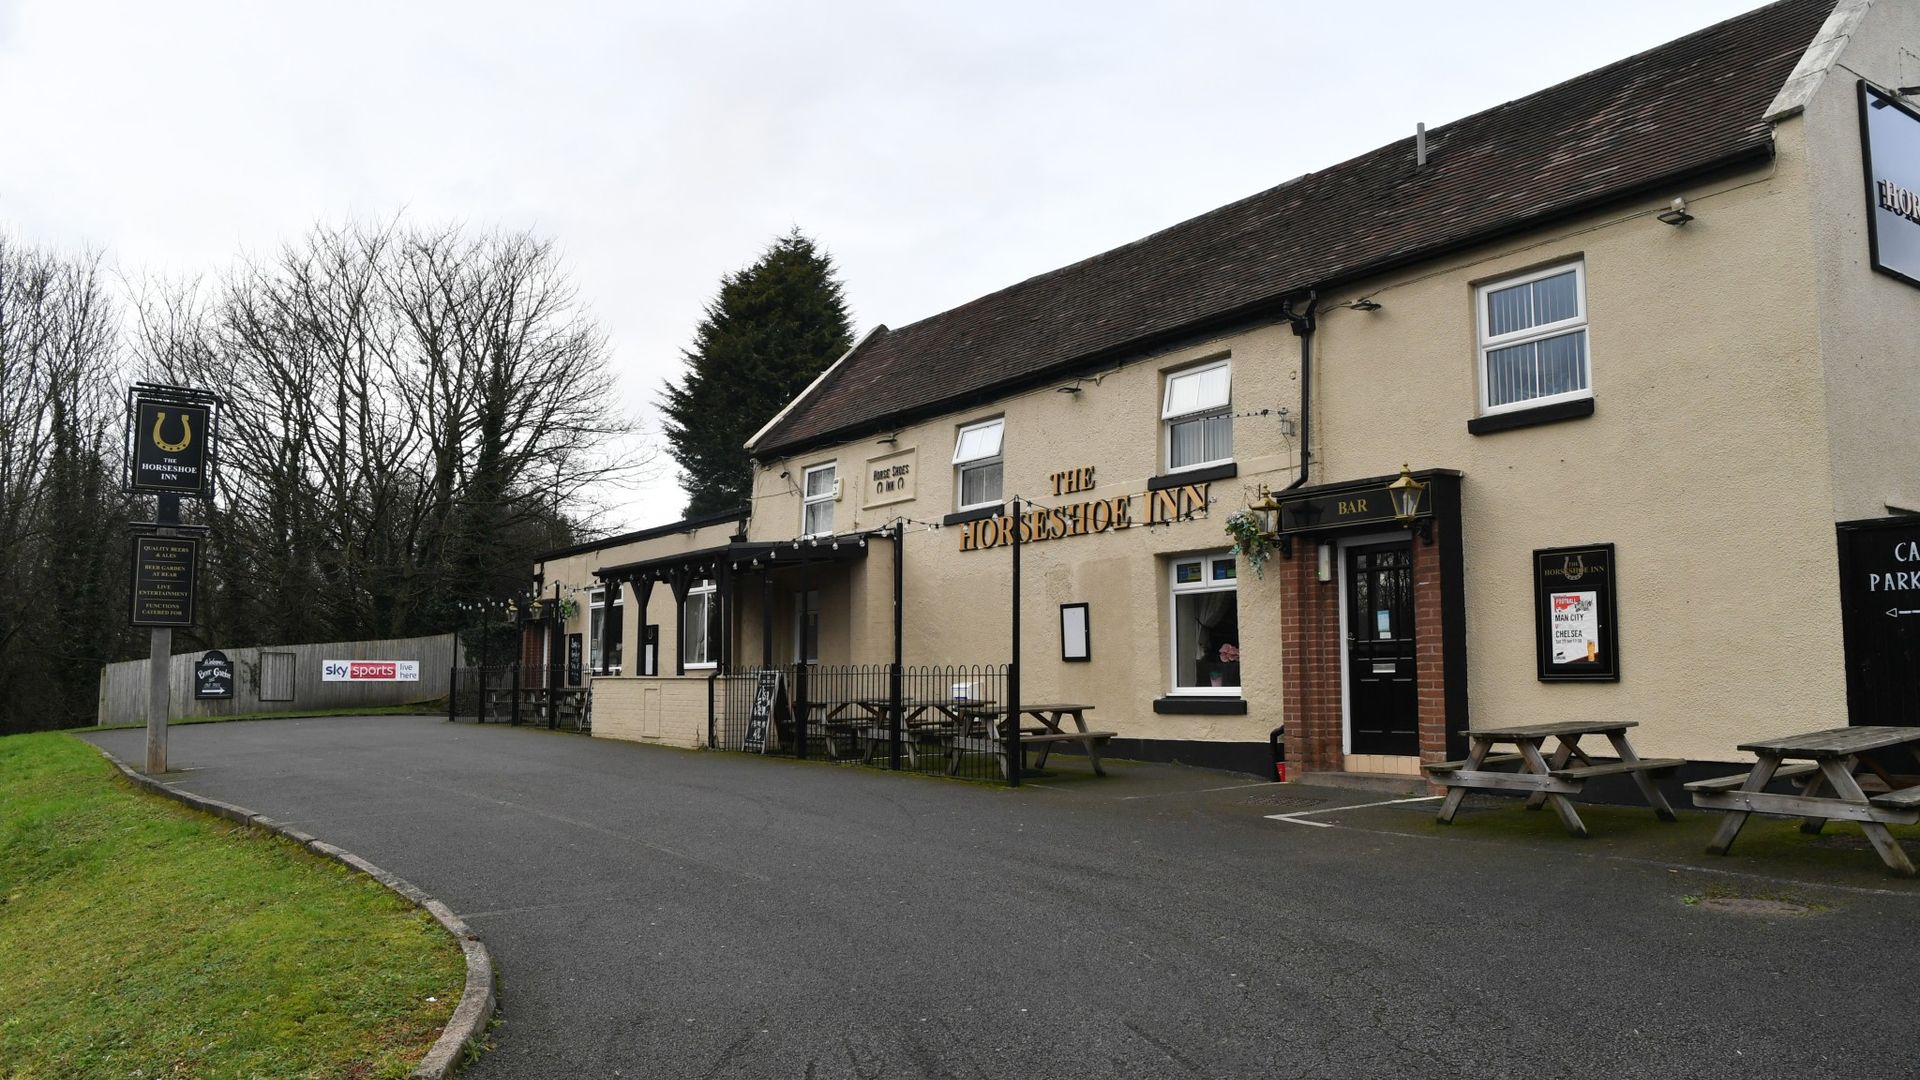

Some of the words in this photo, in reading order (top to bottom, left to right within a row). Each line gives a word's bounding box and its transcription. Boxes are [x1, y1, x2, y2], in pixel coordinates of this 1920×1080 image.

[142, 463, 198, 474] HORSESHOE
[873, 468, 890, 481] HORSE
[892, 464, 910, 477] SHOES
[161, 473, 177, 481] INN
[1050, 465, 1096, 496] THE
[1338, 498, 1368, 515] BAR
[959, 494, 1132, 552] HORSESHOE
[1143, 482, 1211, 525] INN
[1555, 613, 1569, 621] MAN
[1570, 613, 1584, 621] CITY
[1555, 630, 1583, 638] CHELSEA
[325, 663, 348, 678] sky
[352, 665, 395, 678] sports
[400, 663, 413, 671] live
